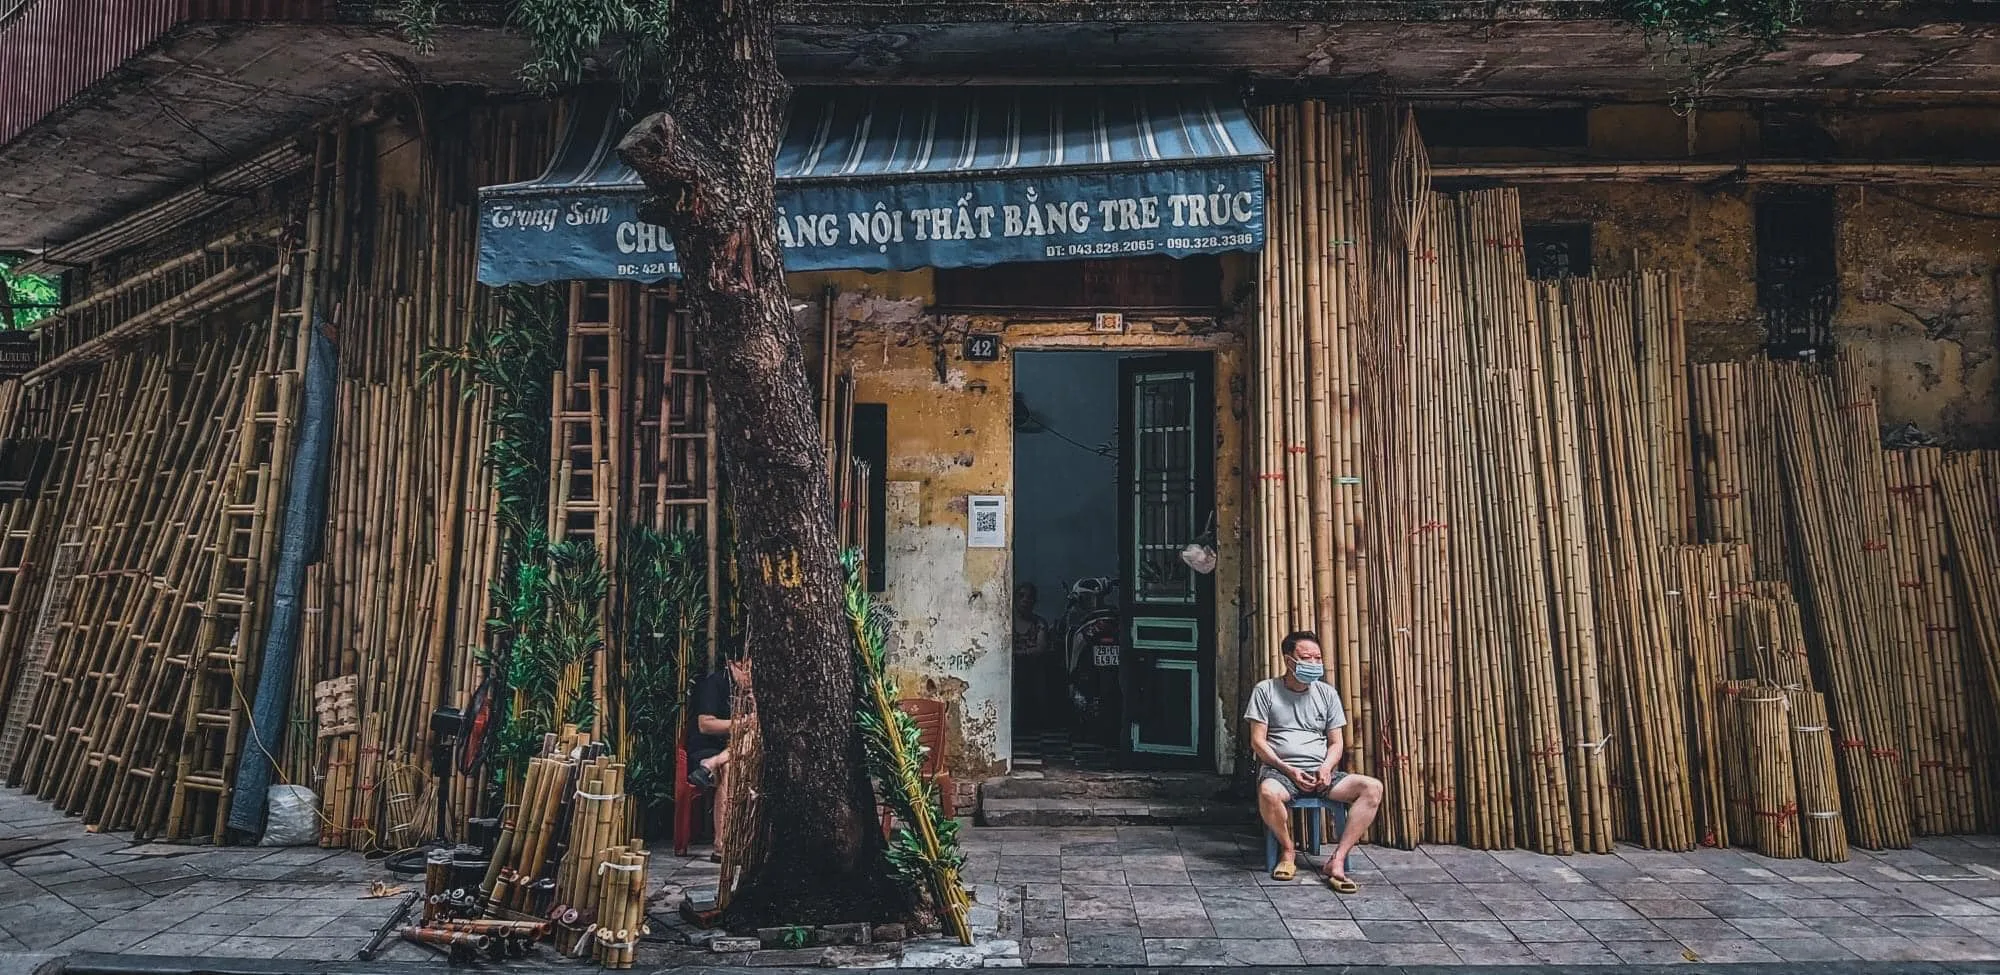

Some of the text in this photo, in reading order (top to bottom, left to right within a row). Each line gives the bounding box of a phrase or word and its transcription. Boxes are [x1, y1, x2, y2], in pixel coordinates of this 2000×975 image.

[491, 202, 609, 232] Trọng Sơn
[616, 183, 1253, 254] CHU ÀNG NỘI THẤT BẰNG TRE TRÚC
[1068, 239, 1155, 256] 043.828.2065
[1167, 233, 1253, 250] 090.328.3386
[642, 262, 665, 274] 42A
[972, 340, 992, 356] 42
